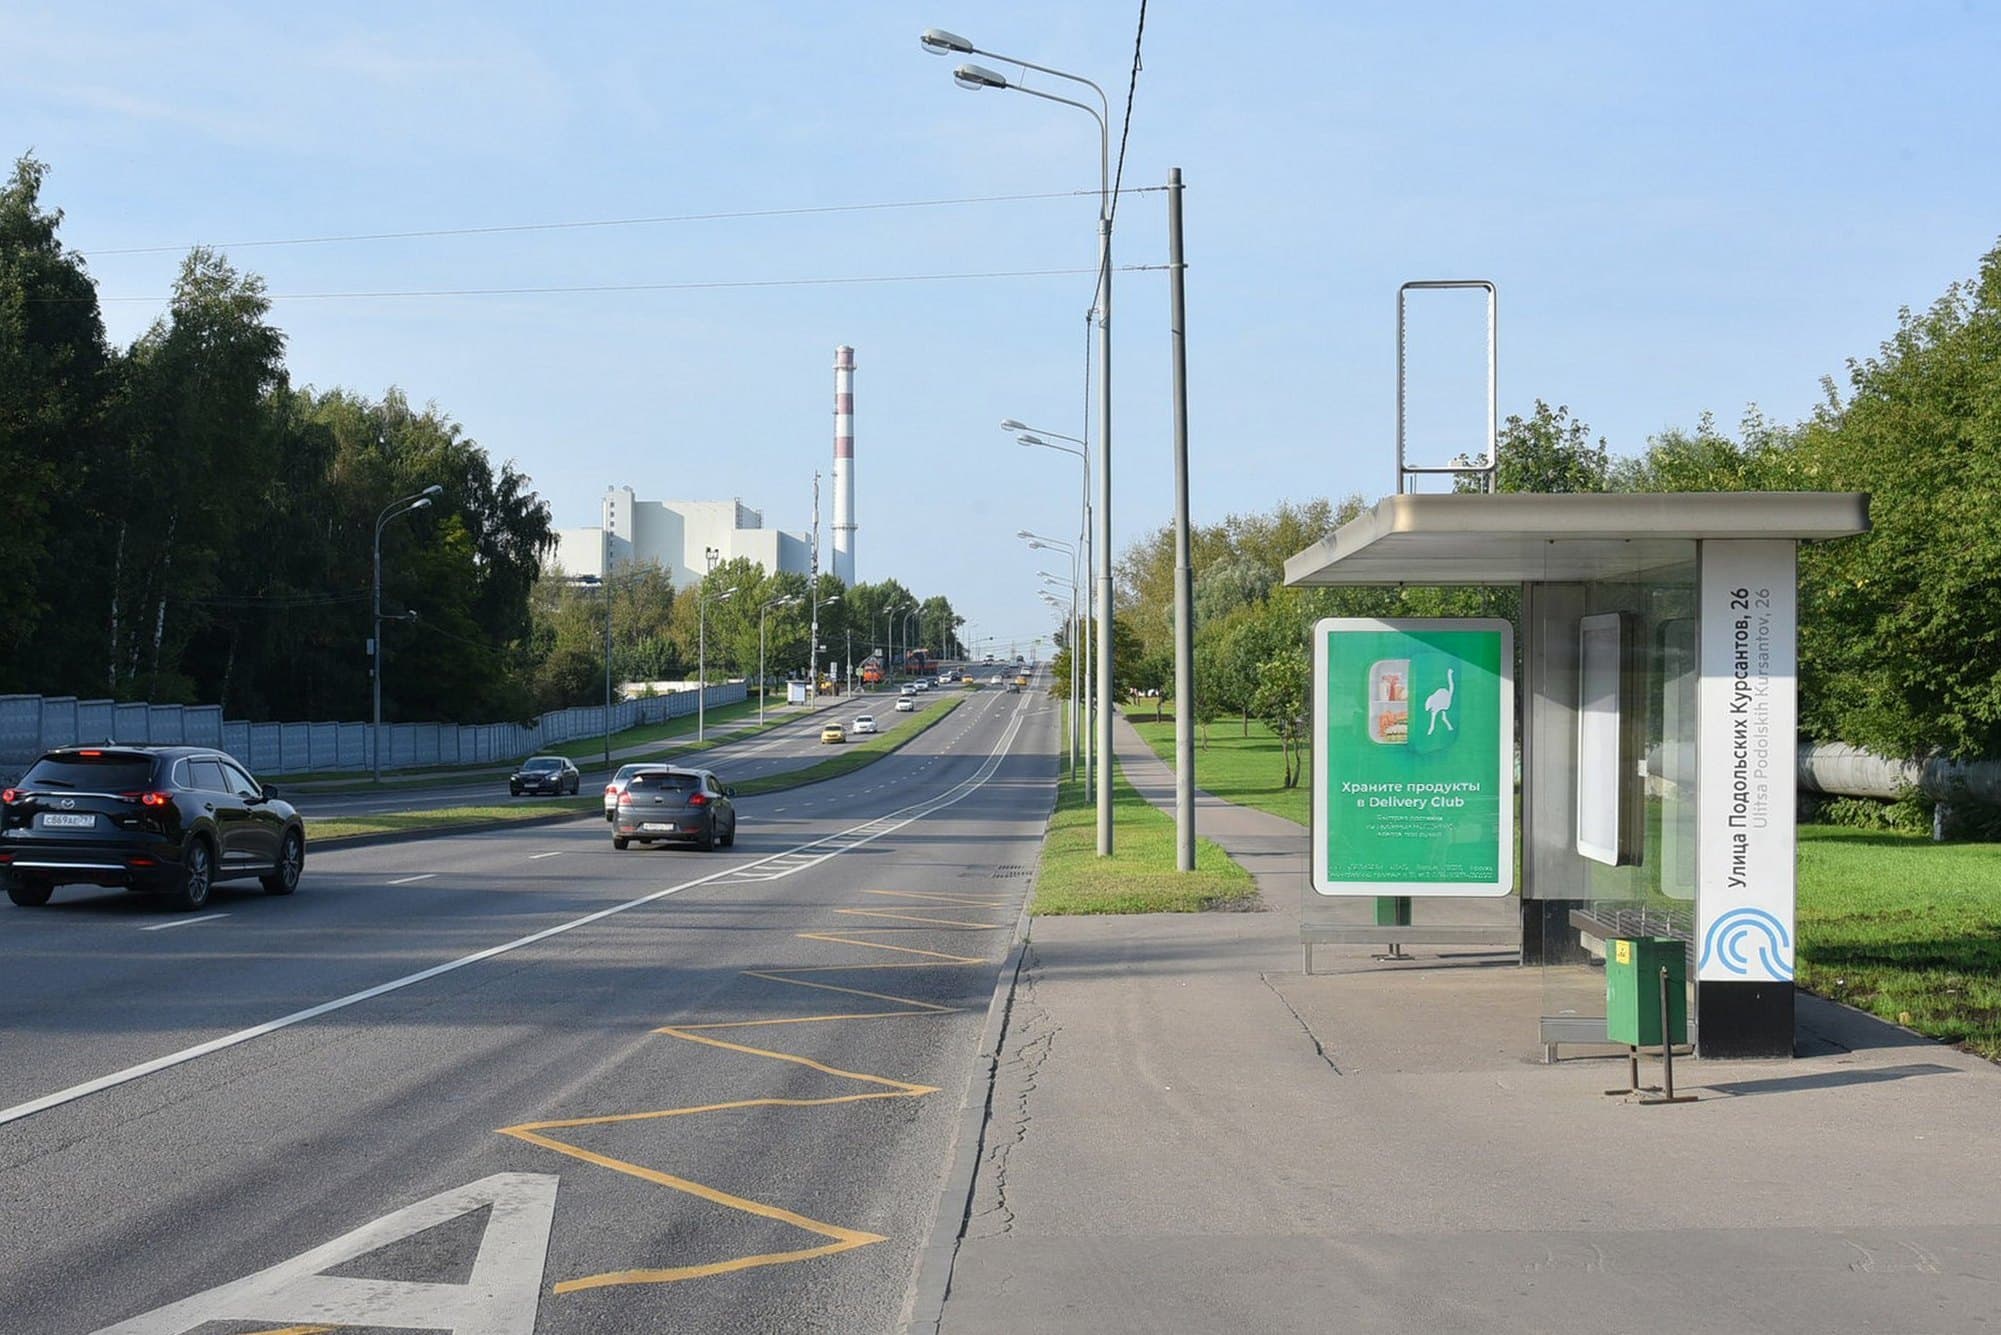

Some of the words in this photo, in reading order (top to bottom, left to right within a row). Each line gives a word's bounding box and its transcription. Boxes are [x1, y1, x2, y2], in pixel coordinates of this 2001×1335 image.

[1730, 588, 1749, 610] 26
[1755, 588, 1770, 608] 26
[1730, 615, 1752, 713] Курсантов,
[1755, 613, 1771, 697] Kursantov,
[1754, 702, 1769, 778] Podolskih
[1342, 781, 1403, 794] Храните
[1406, 781, 1481, 794] продукты
[1729, 719, 1750, 827] Подольских
[1357, 799, 1365, 808] в
[1369, 796, 1427, 809] Delivery
[1431, 796, 1465, 808] Club
[1752, 784, 1768, 829] Ulitsa
[1728, 833, 1749, 888] Улица
